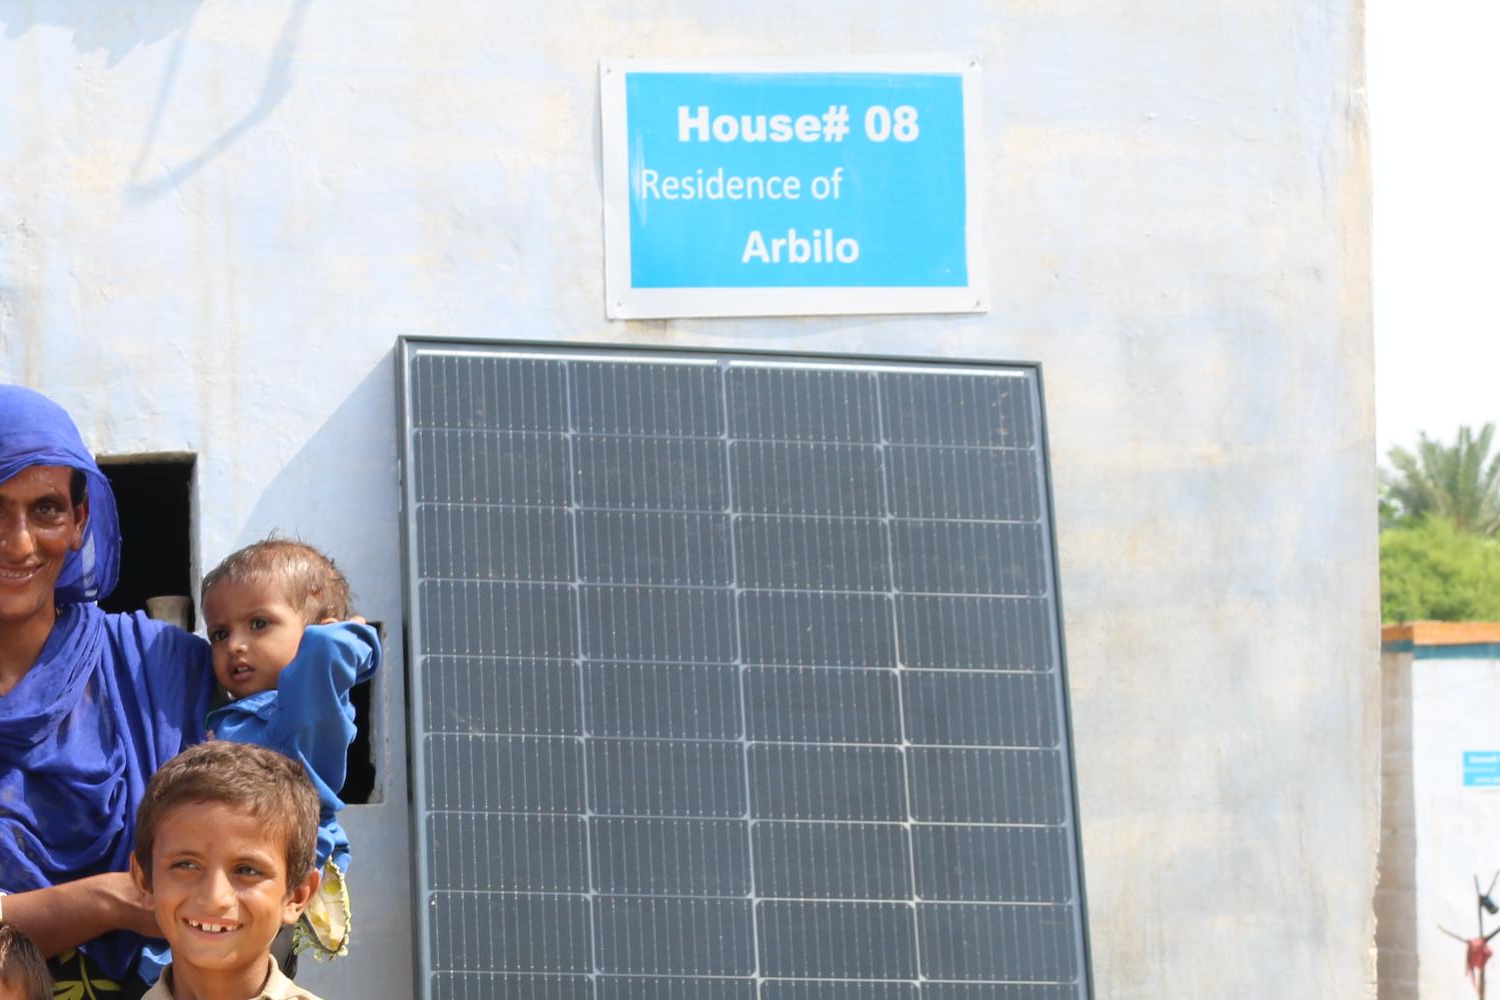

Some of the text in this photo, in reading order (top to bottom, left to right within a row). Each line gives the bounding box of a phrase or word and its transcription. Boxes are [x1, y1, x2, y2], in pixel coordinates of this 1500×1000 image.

[678, 105, 920, 143] House# 08
[641, 166, 844, 200] Residence of
[741, 228, 859, 264] Arbilo
